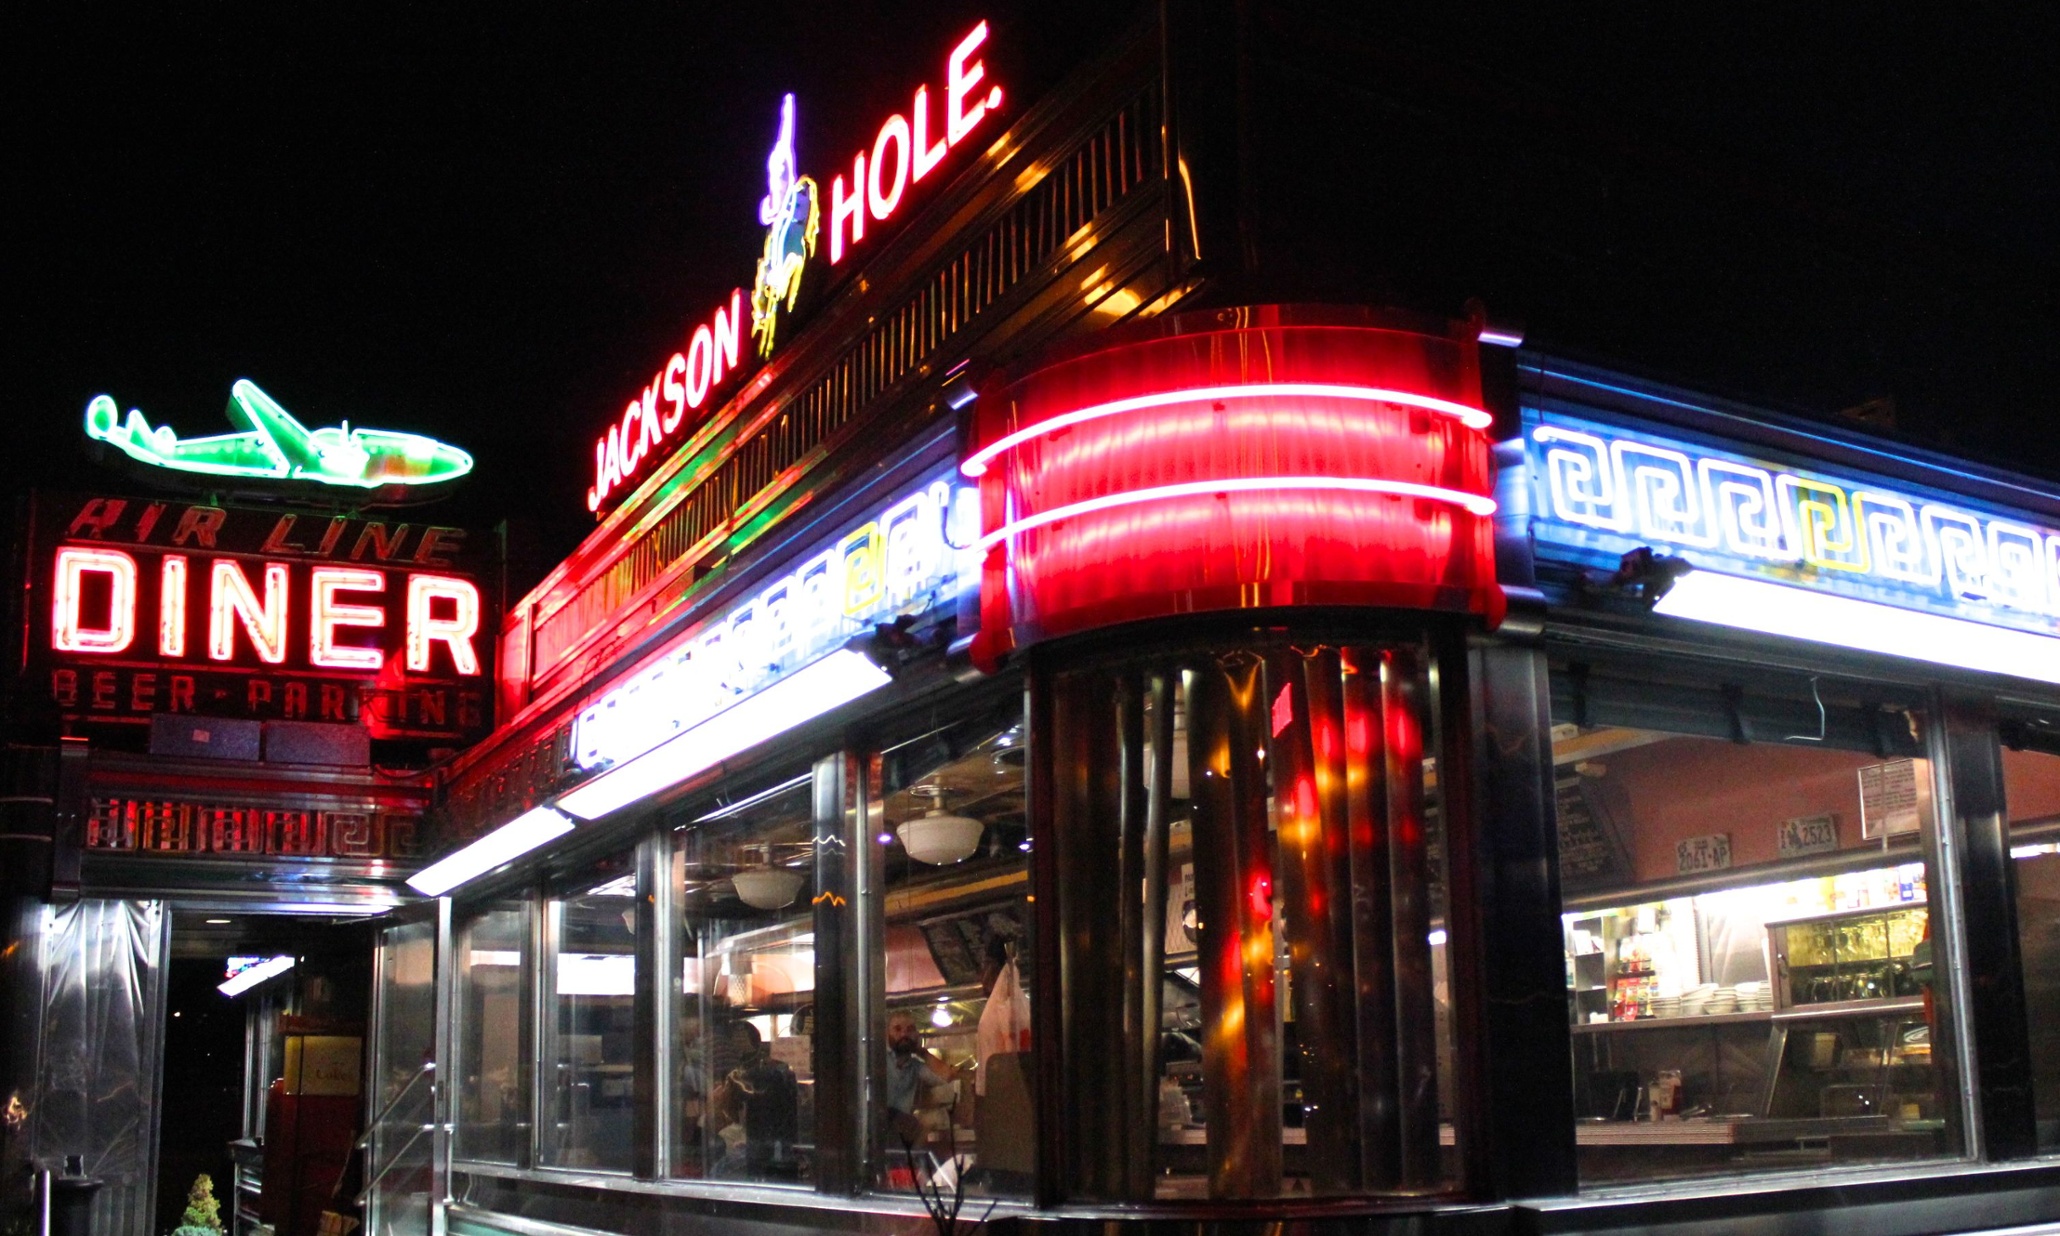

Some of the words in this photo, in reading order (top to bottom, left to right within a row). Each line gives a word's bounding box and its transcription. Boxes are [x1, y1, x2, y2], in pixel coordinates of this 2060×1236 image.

[588, 288, 742, 512] JACKSON
[52, 545, 481, 675] DINER
[52, 669, 195, 712] BEER
